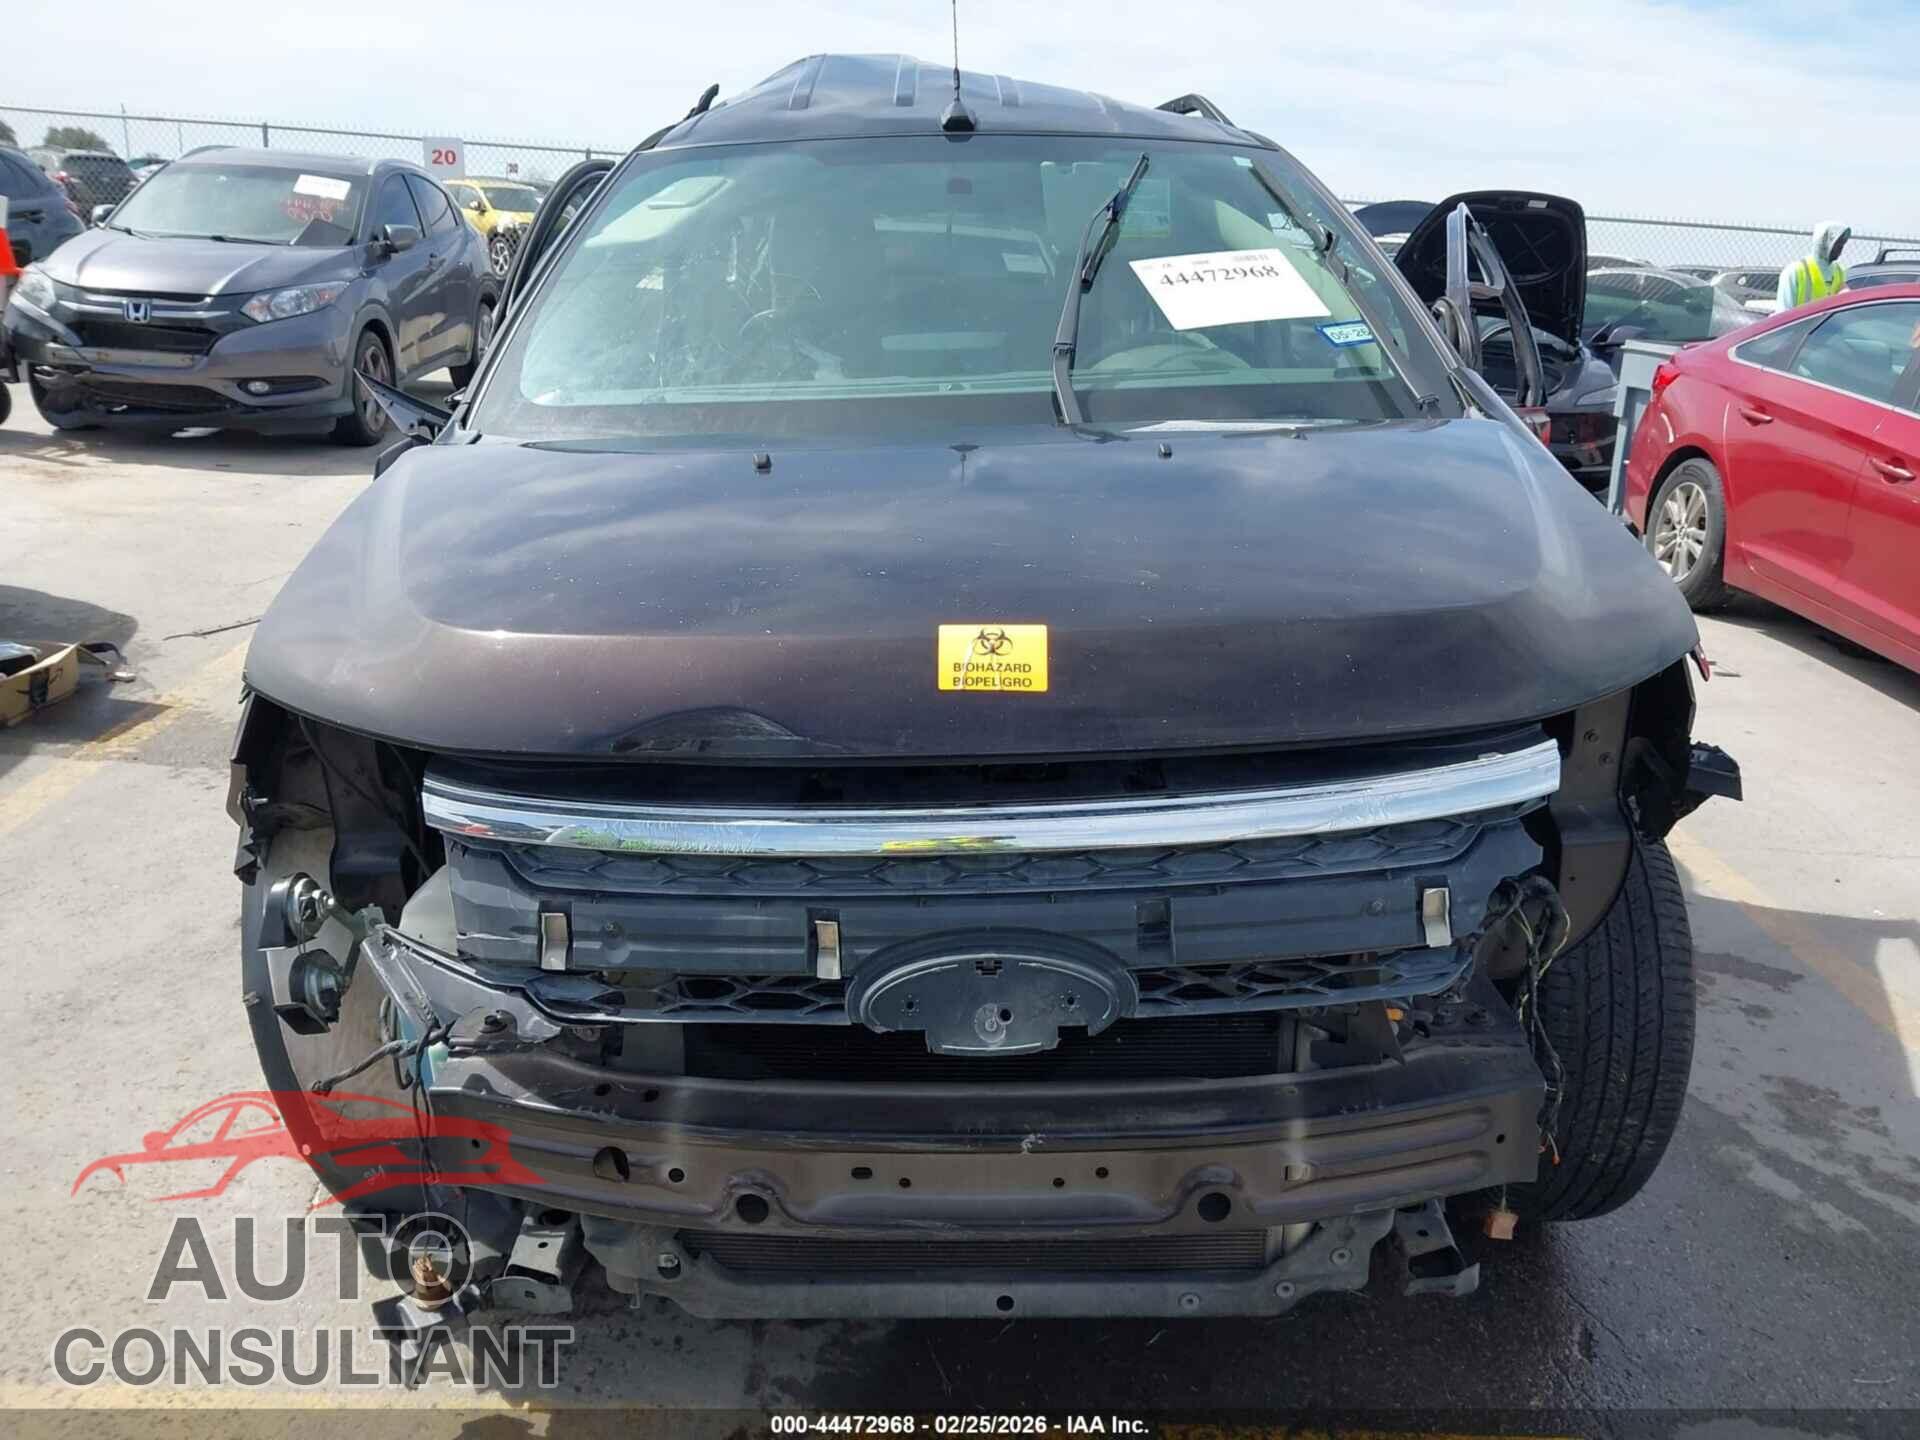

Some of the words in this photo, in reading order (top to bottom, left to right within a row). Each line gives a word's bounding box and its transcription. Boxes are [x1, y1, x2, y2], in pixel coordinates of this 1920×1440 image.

[432, 149, 456, 166] 20
[1159, 265, 1280, 286] 44472968
[953, 662, 1032, 673] BIOHAZARD
[952, 676, 1033, 688] BIOPELIGRO
